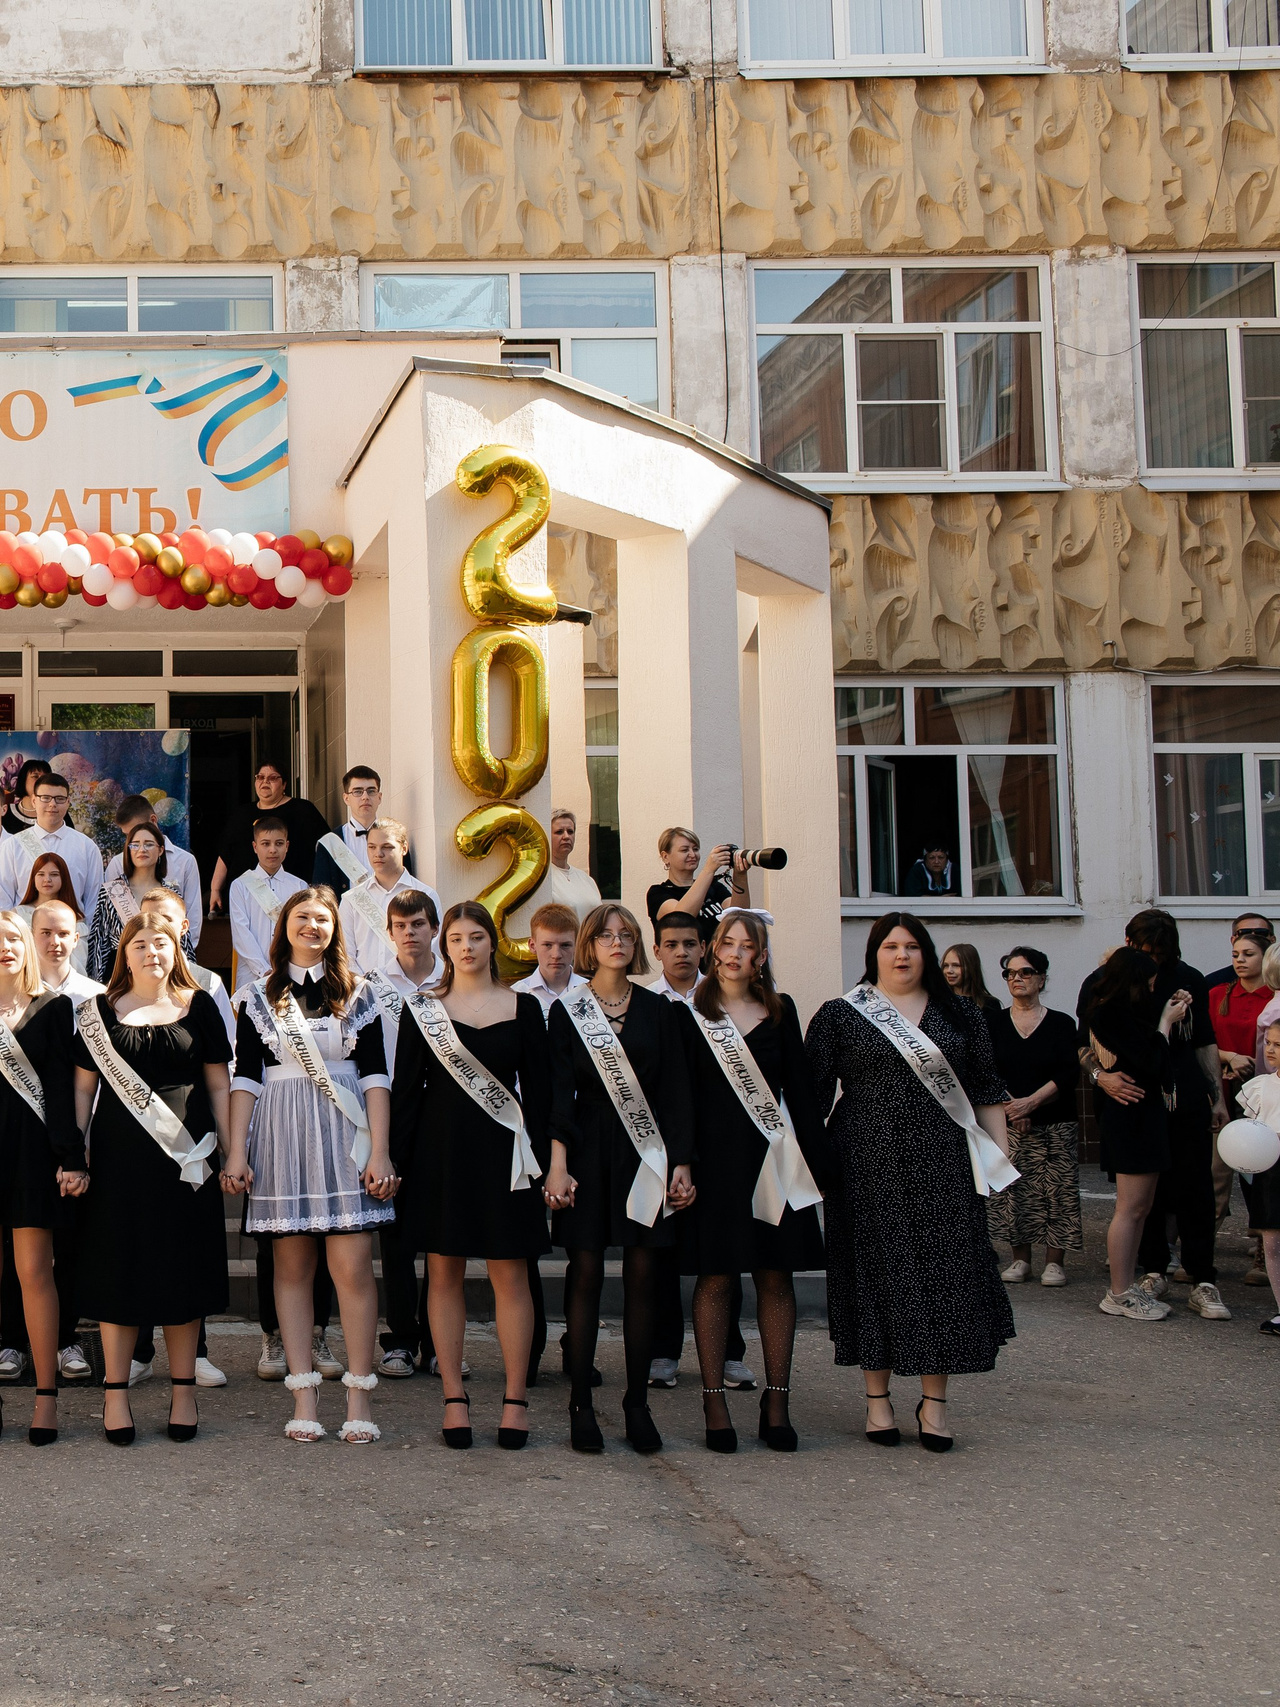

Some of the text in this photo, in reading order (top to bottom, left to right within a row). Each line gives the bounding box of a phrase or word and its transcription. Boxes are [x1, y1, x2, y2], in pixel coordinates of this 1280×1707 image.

[183, 719, 215, 728] ВХОД
[80, 1012, 156, 1110] Выпускница 2025
[419, 1011, 510, 1110] Выпускник 2025
[581, 1022, 655, 1139] Выпускник 2025
[702, 1019, 784, 1131] Выпускник 2025
[864, 1001, 956, 1095] Выпускник 2025
